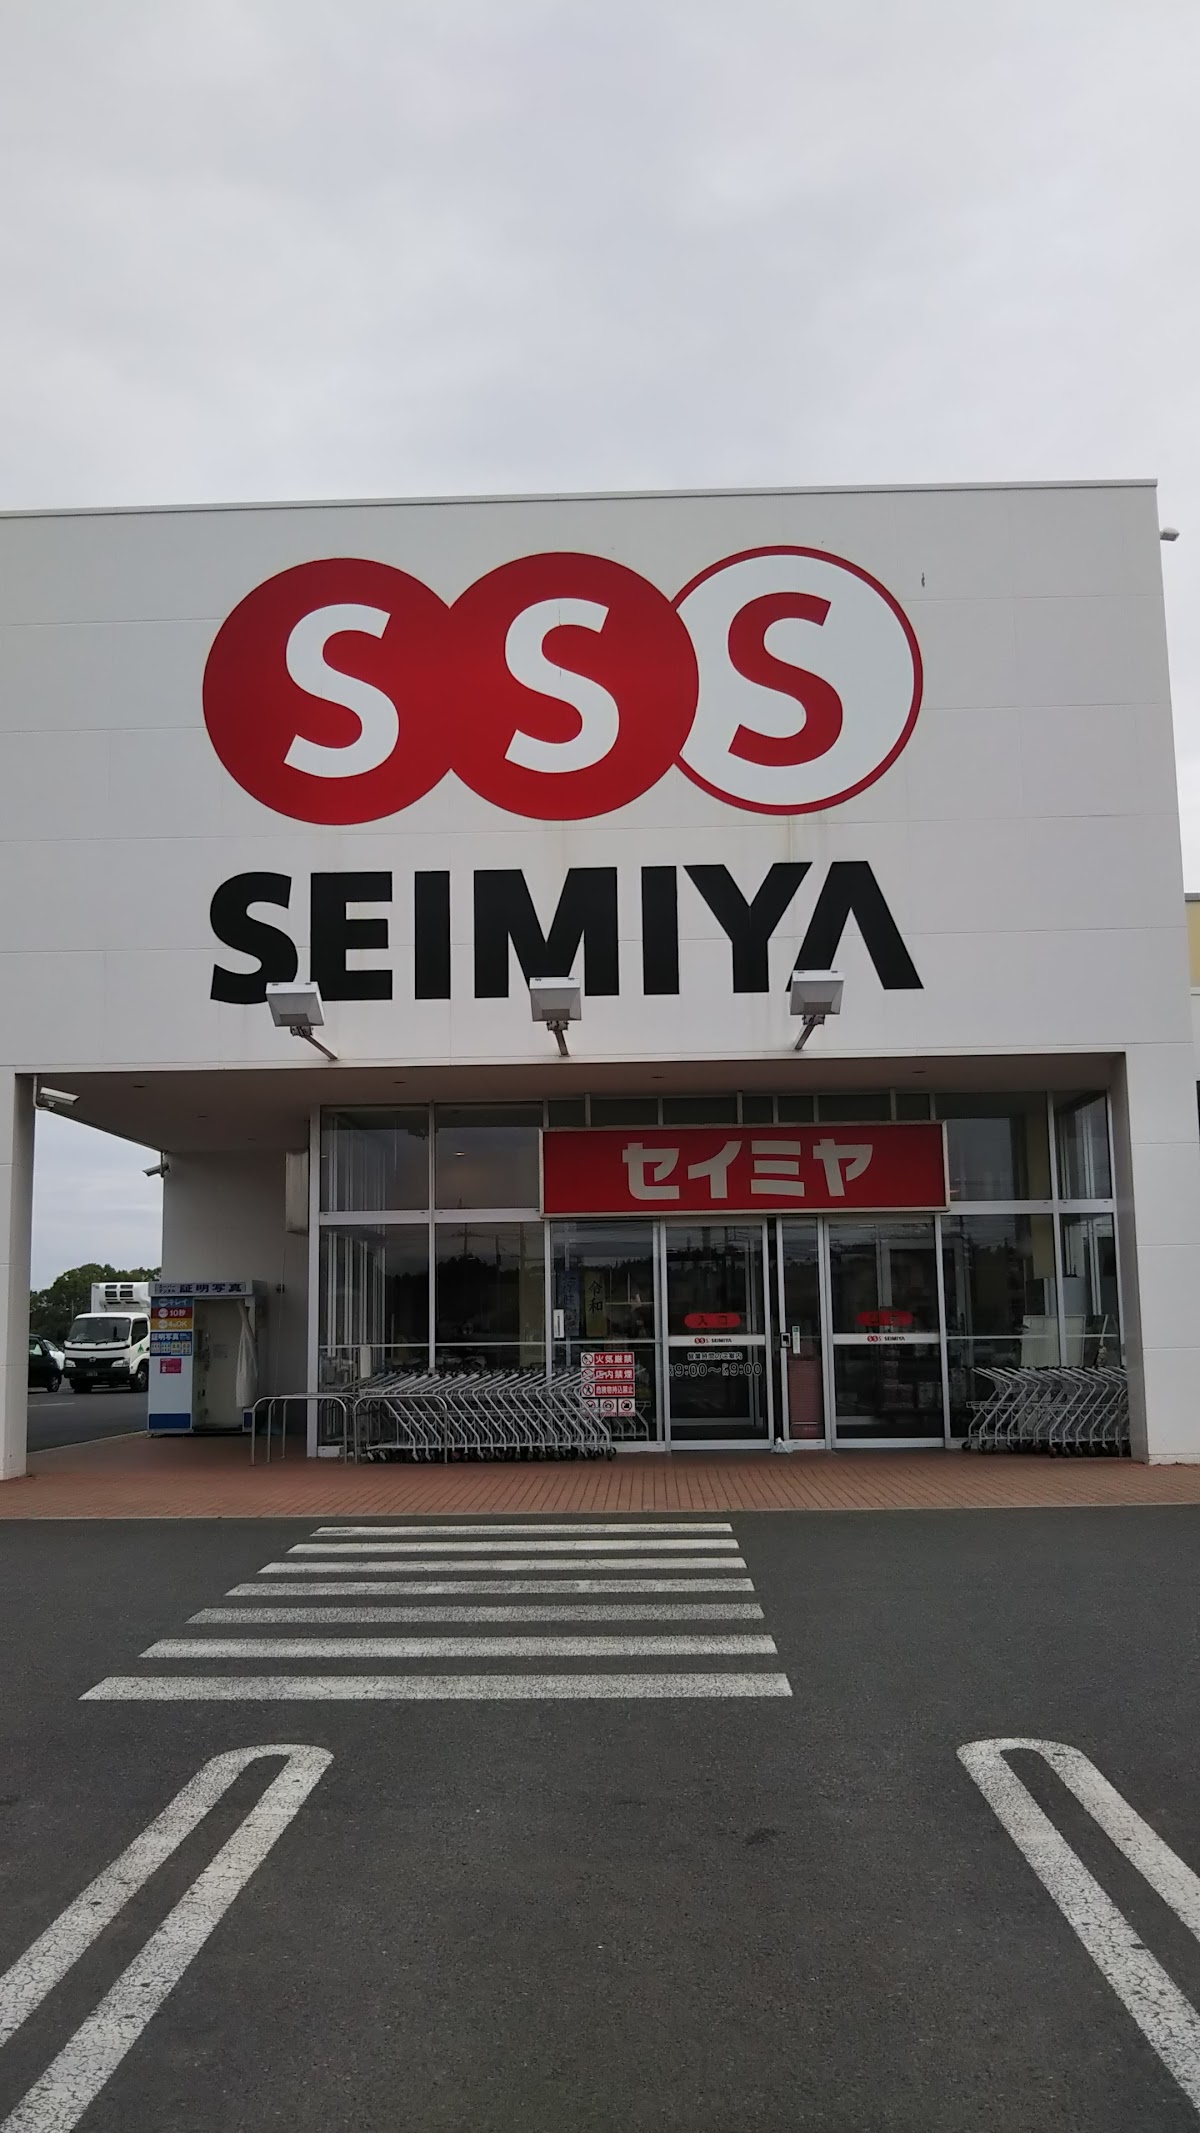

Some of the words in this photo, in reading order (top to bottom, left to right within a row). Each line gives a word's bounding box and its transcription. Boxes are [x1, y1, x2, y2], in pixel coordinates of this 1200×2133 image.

[209, 860, 924, 1004] SEIMIYA
[622, 1138, 874, 1201] セイミヤ
[179, 1283, 242, 1293] 証明写真
[588, 1280, 603, 1315] 令和
[697, 1315, 728, 1326] 入口
[595, 1354, 633, 1364] 火気厳禁
